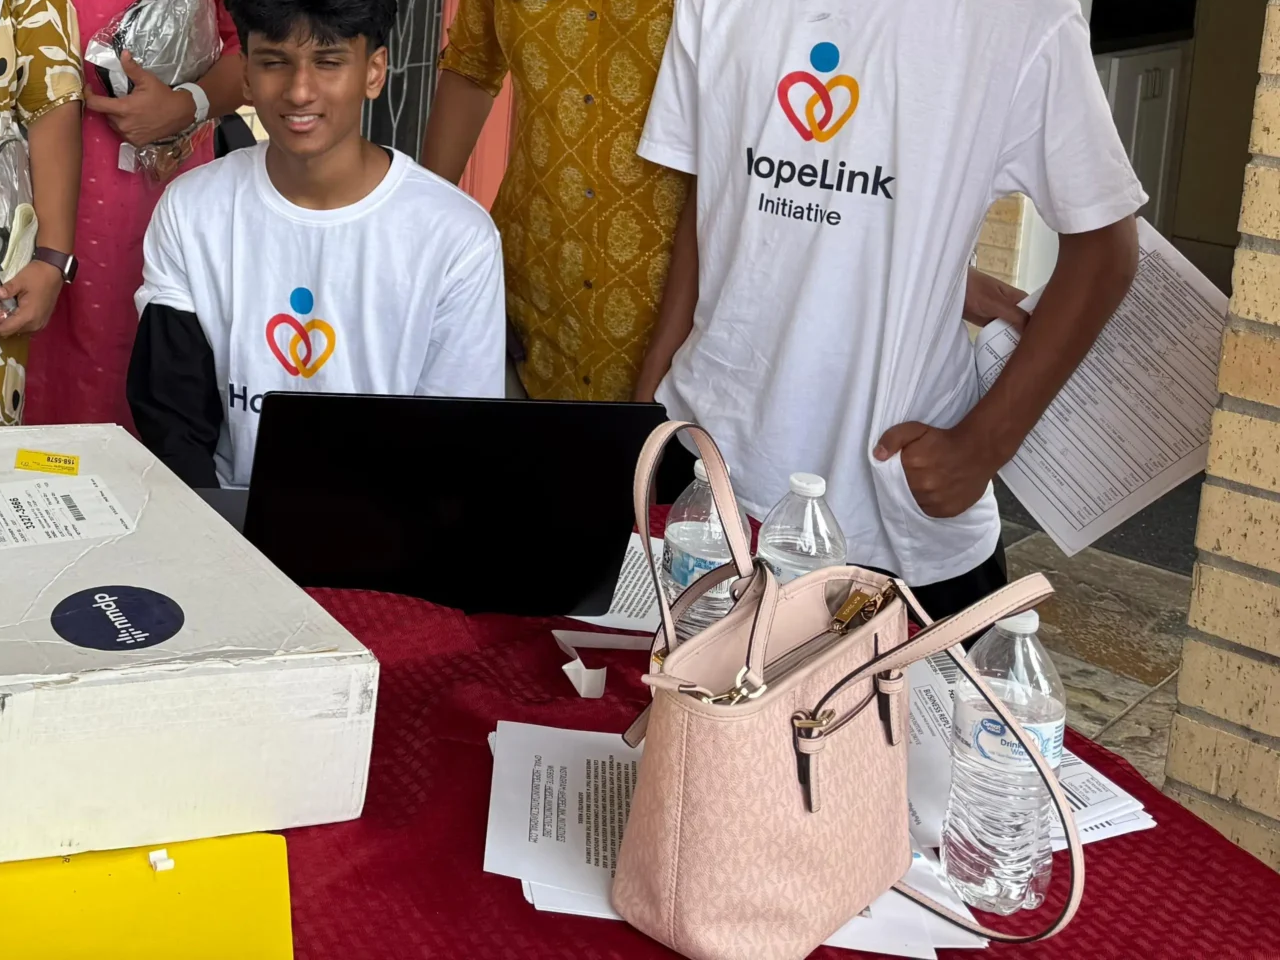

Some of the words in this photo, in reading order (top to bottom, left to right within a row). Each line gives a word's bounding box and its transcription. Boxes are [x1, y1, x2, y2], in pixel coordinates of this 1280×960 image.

[758, 193, 841, 225] Initiative
[92, 593, 132, 629] nmdp
[923, 688, 942, 715] BUSINESS
[939, 711, 952, 730] REPLY
[982, 719, 1002, 730] Great
